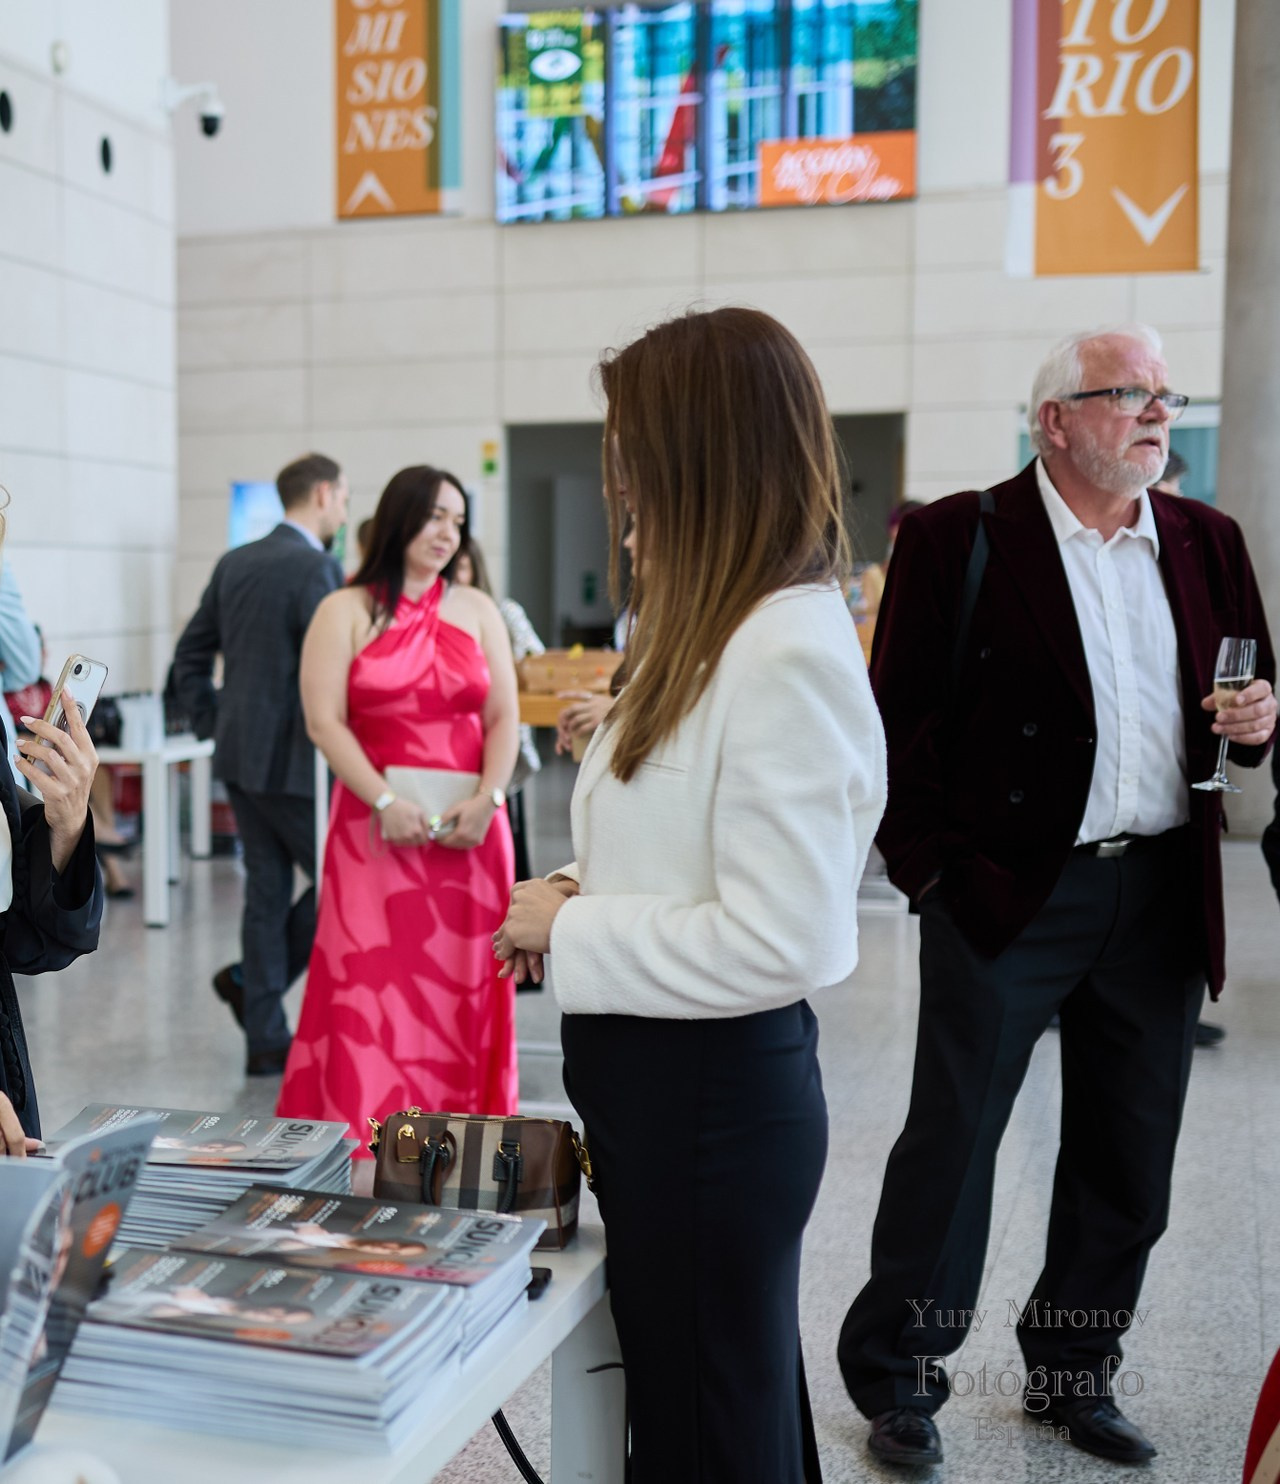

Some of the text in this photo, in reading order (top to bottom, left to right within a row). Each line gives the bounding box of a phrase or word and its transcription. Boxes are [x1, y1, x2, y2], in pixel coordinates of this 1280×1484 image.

[344, 11, 409, 57] MI
[346, 57, 428, 106] SIO
[1042, 46, 1195, 120] RIO
[344, 105, 438, 154] NES
[1043, 132, 1087, 200] 3
